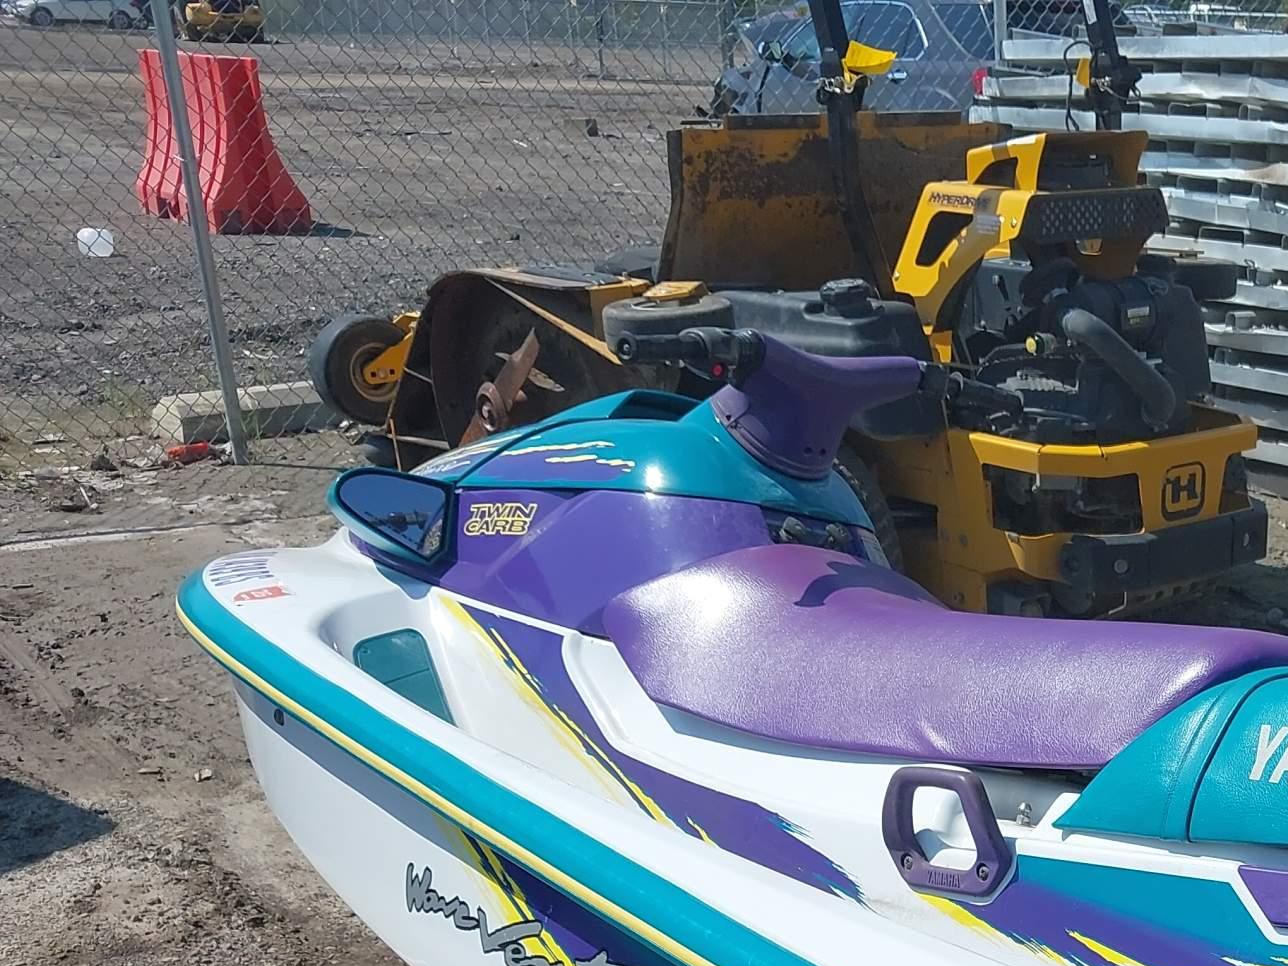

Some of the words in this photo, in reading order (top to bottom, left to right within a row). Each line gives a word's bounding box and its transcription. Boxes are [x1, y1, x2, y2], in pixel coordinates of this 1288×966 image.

[469, 503, 538, 521] TWIN
[464, 519, 530, 536] CARB
[926, 870, 961, 889] YAMAHA
